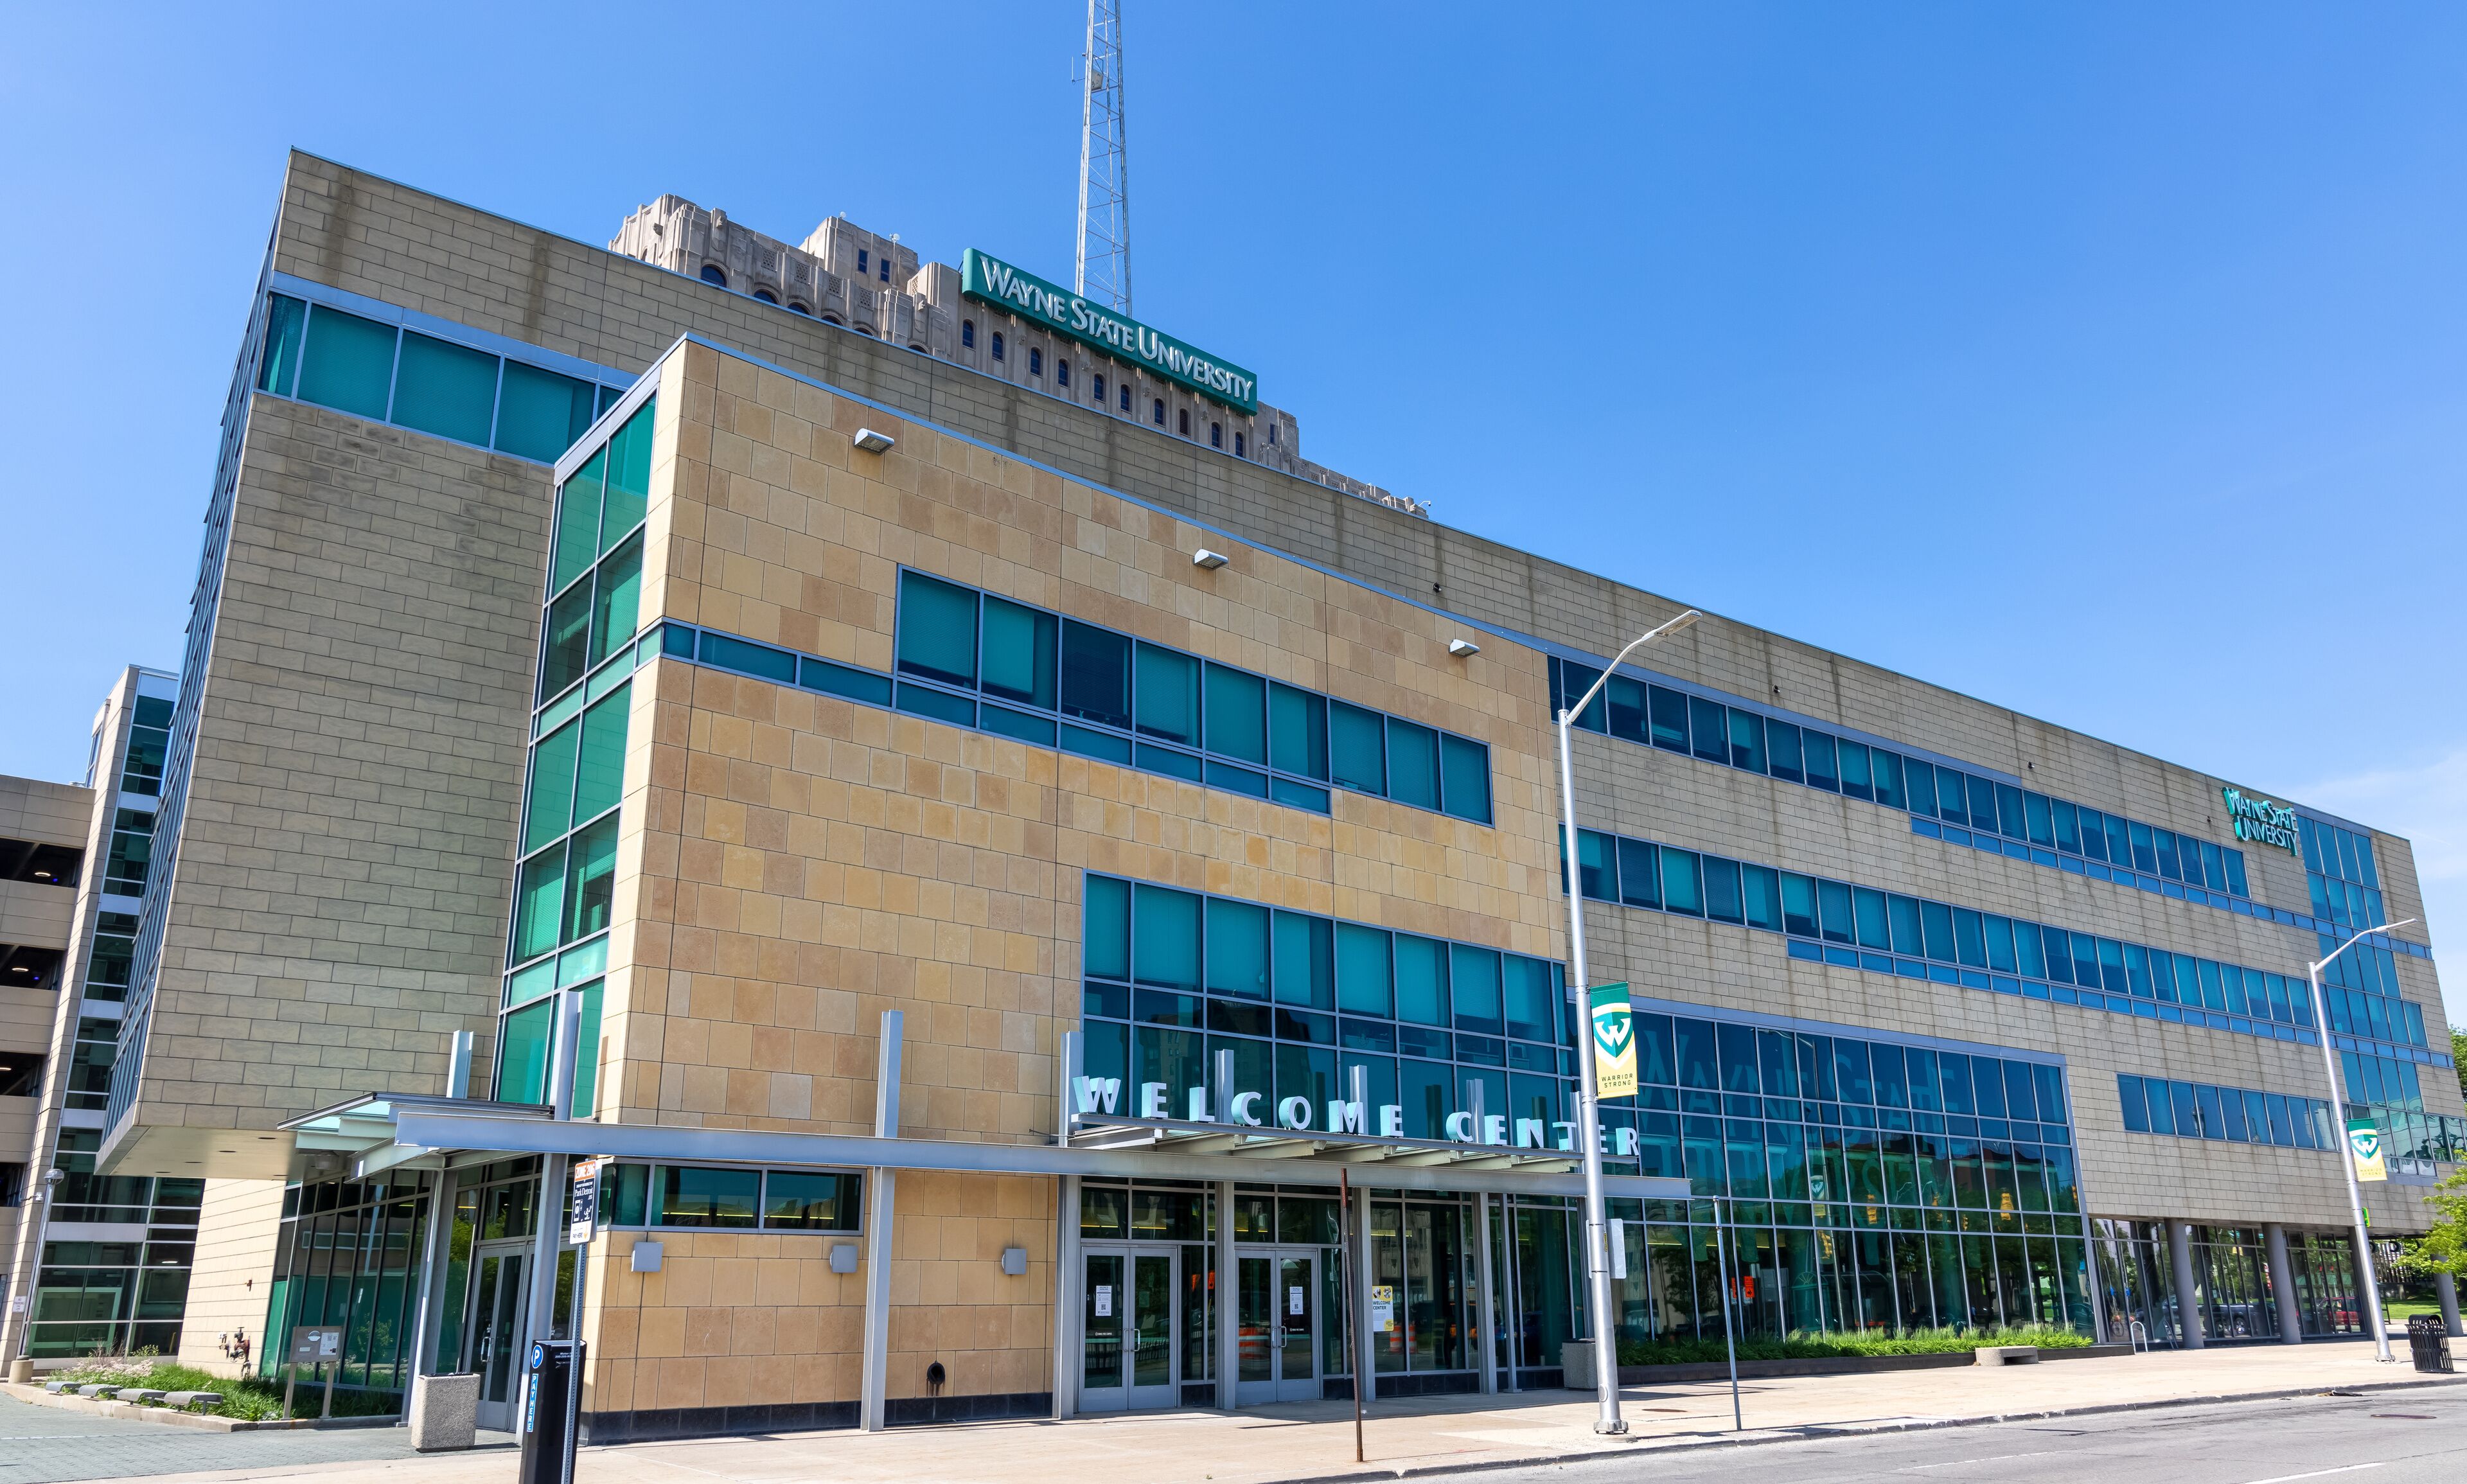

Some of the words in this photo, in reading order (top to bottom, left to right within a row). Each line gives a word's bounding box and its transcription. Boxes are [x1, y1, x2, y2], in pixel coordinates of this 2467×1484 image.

[980, 256, 1066, 322] WAYNE
[1071, 298, 1135, 352] STATE
[1139, 326, 1253, 402] UNIVERSITY
[2221, 787, 2267, 822] WAYNE
[2262, 800, 2299, 832] STATE
[2233, 816, 2298, 856] UNIVERSITY
[1072, 1076, 1404, 1137] WELCOME
[1446, 1111, 1639, 1156] CENTER
[533, 1349, 540, 1365] P
